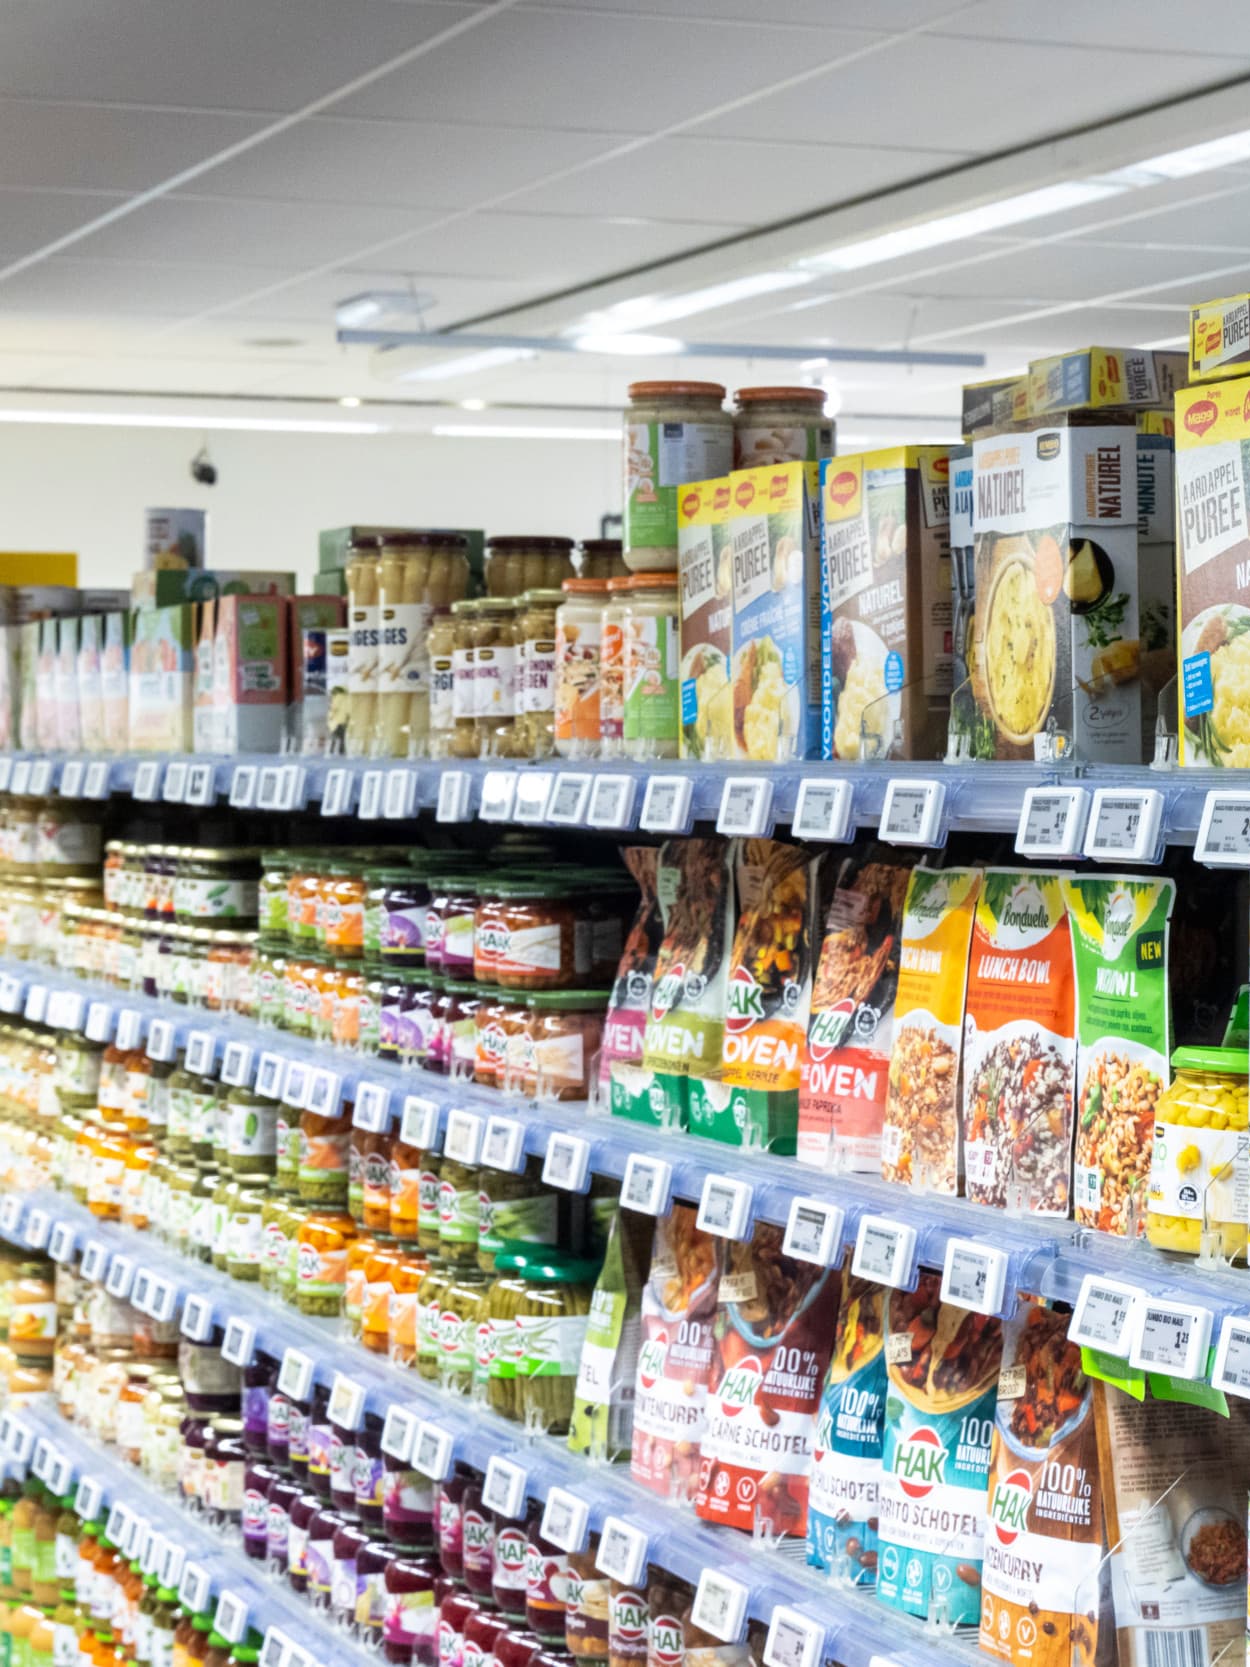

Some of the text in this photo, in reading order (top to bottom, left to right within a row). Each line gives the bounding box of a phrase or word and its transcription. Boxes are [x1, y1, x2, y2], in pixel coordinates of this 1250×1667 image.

[1222, 302, 1249, 325] AARDAPPEL
[1223, 316, 1250, 349] PUREE
[1187, 409, 1215, 425] Maggi
[977, 468, 1027, 520] NATUREL
[1098, 444, 1122, 518] NATUREL
[1137, 453, 1156, 515] MINUTE
[1183, 458, 1239, 506] AARDAPPEL
[1183, 485, 1243, 549] PUREE
[829, 553, 870, 592] PUREE
[1002, 903, 1050, 934] Bonduelle
[1140, 940, 1163, 961] NEW
[976, 954, 1051, 985] LUNCH BOWL
[722, 1033, 798, 1070] OVEN
[808, 1063, 878, 1100] OVEN
[1146, 1311, 1185, 1328] JUMBO BIO MAIS
[718, 1369, 763, 1406] HAK
[710, 1420, 812, 1458] CARNE SCHOTEL
[894, 1445, 949, 1486] HAK
[1039, 1460, 1092, 1497] 100%
[911, 1503, 980, 1537] SCHOTEL
[993, 1484, 1033, 1533] HAK
[1036, 1488, 1092, 1517] NATUURLIJKE
[614, 1607, 650, 1630] HAK
